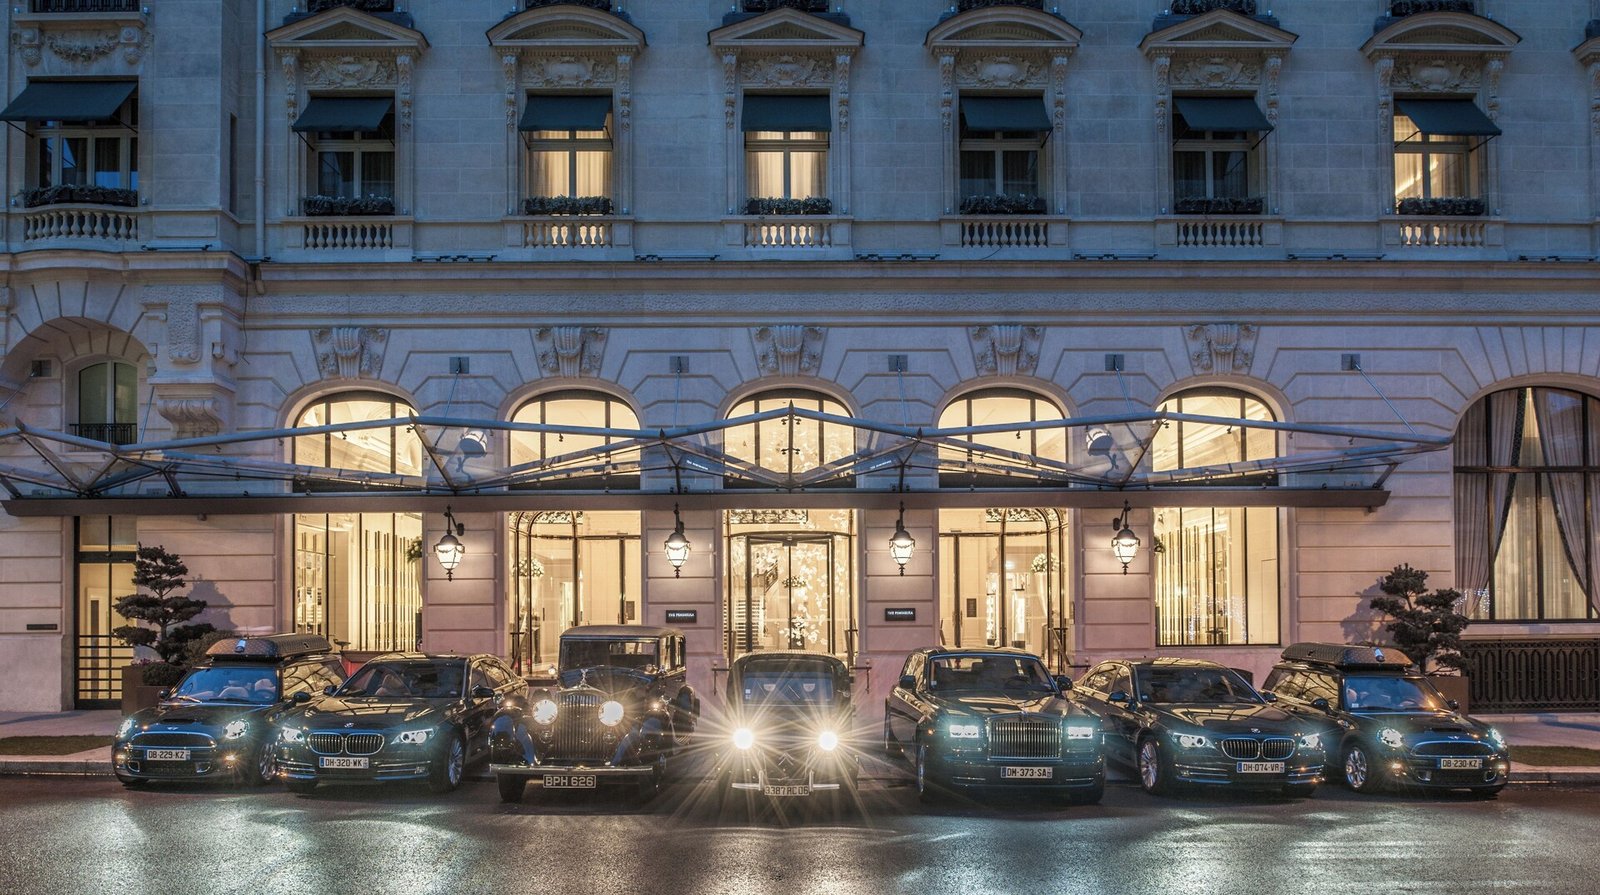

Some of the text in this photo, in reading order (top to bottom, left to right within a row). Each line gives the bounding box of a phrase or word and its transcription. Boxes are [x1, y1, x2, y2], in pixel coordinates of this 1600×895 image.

[148, 750, 185, 759] DB-229-KZ
[325, 758, 362, 767] DH-320-WK
[1243, 763, 1280, 771] DH-074-VR
[1442, 759, 1478, 768] DB-230-KZ
[545, 776, 594, 786] BPH 626
